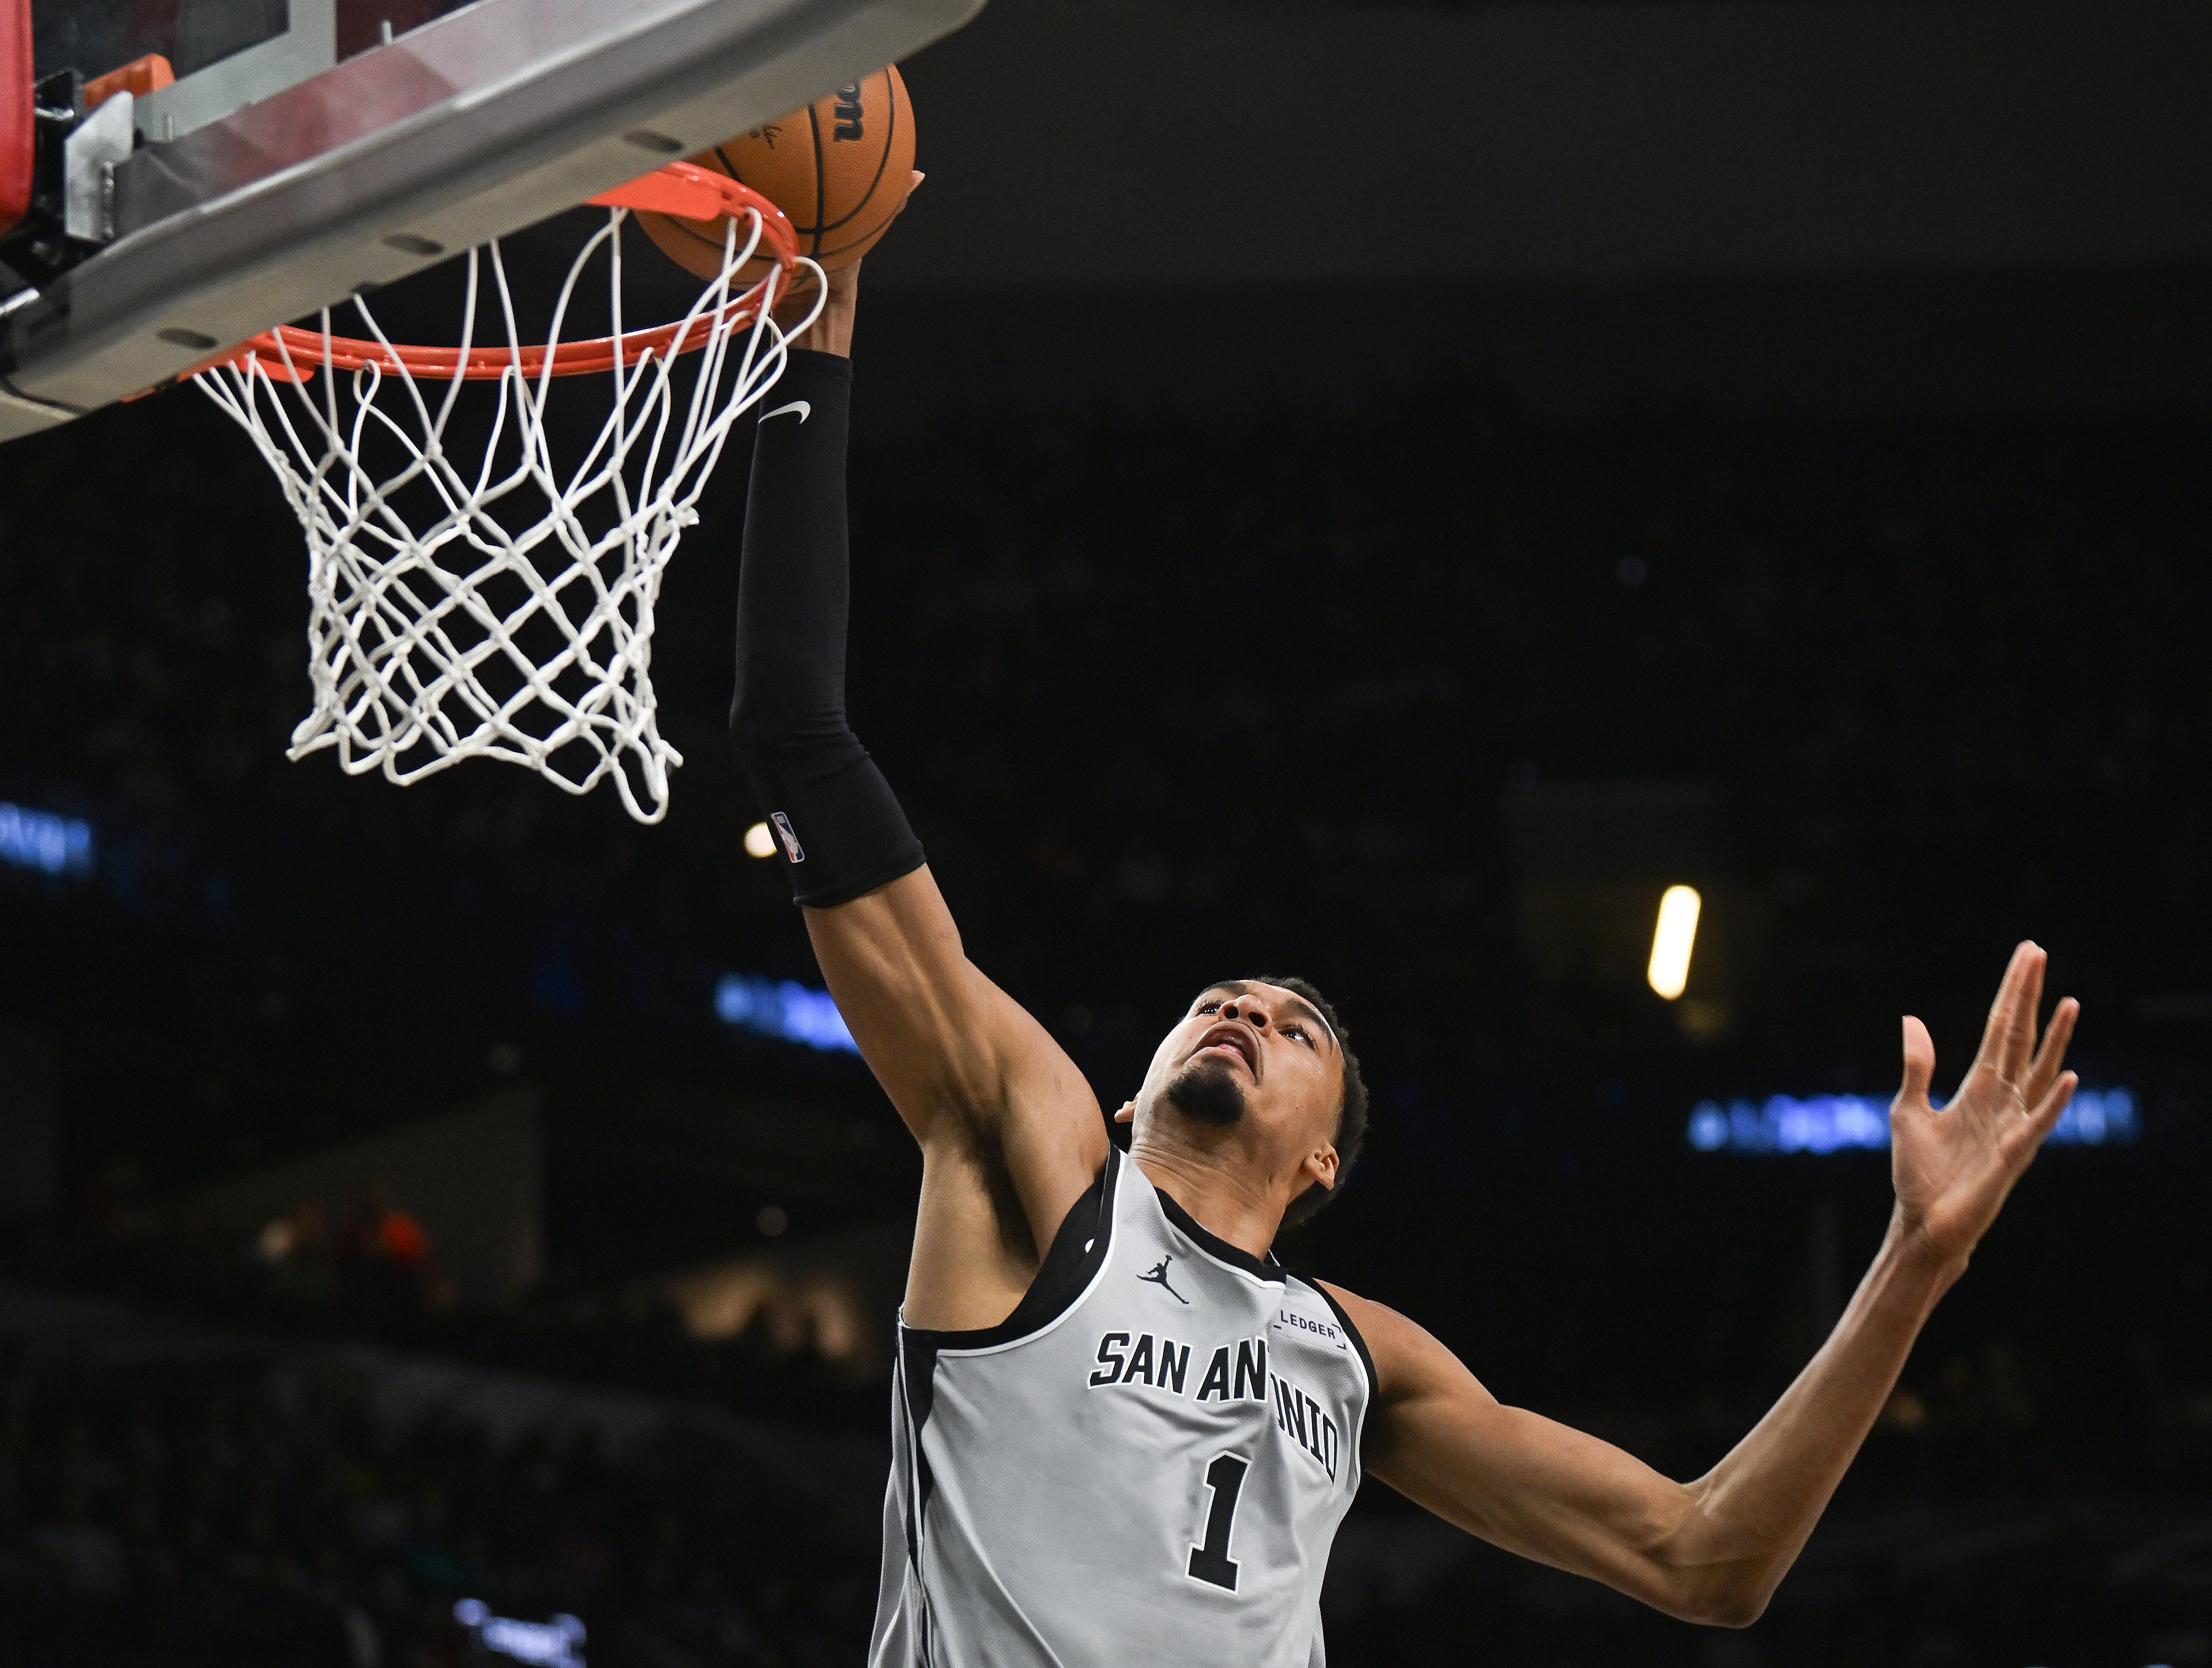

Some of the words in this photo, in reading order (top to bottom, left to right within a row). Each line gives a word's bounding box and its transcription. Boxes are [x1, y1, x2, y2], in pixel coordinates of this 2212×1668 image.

[1280, 1309, 1336, 1340] LEDGER
[1088, 1330, 1194, 1397] SAN
[1193, 1335, 1339, 1487] ANNIO
[1185, 1450, 1252, 1596] 1
